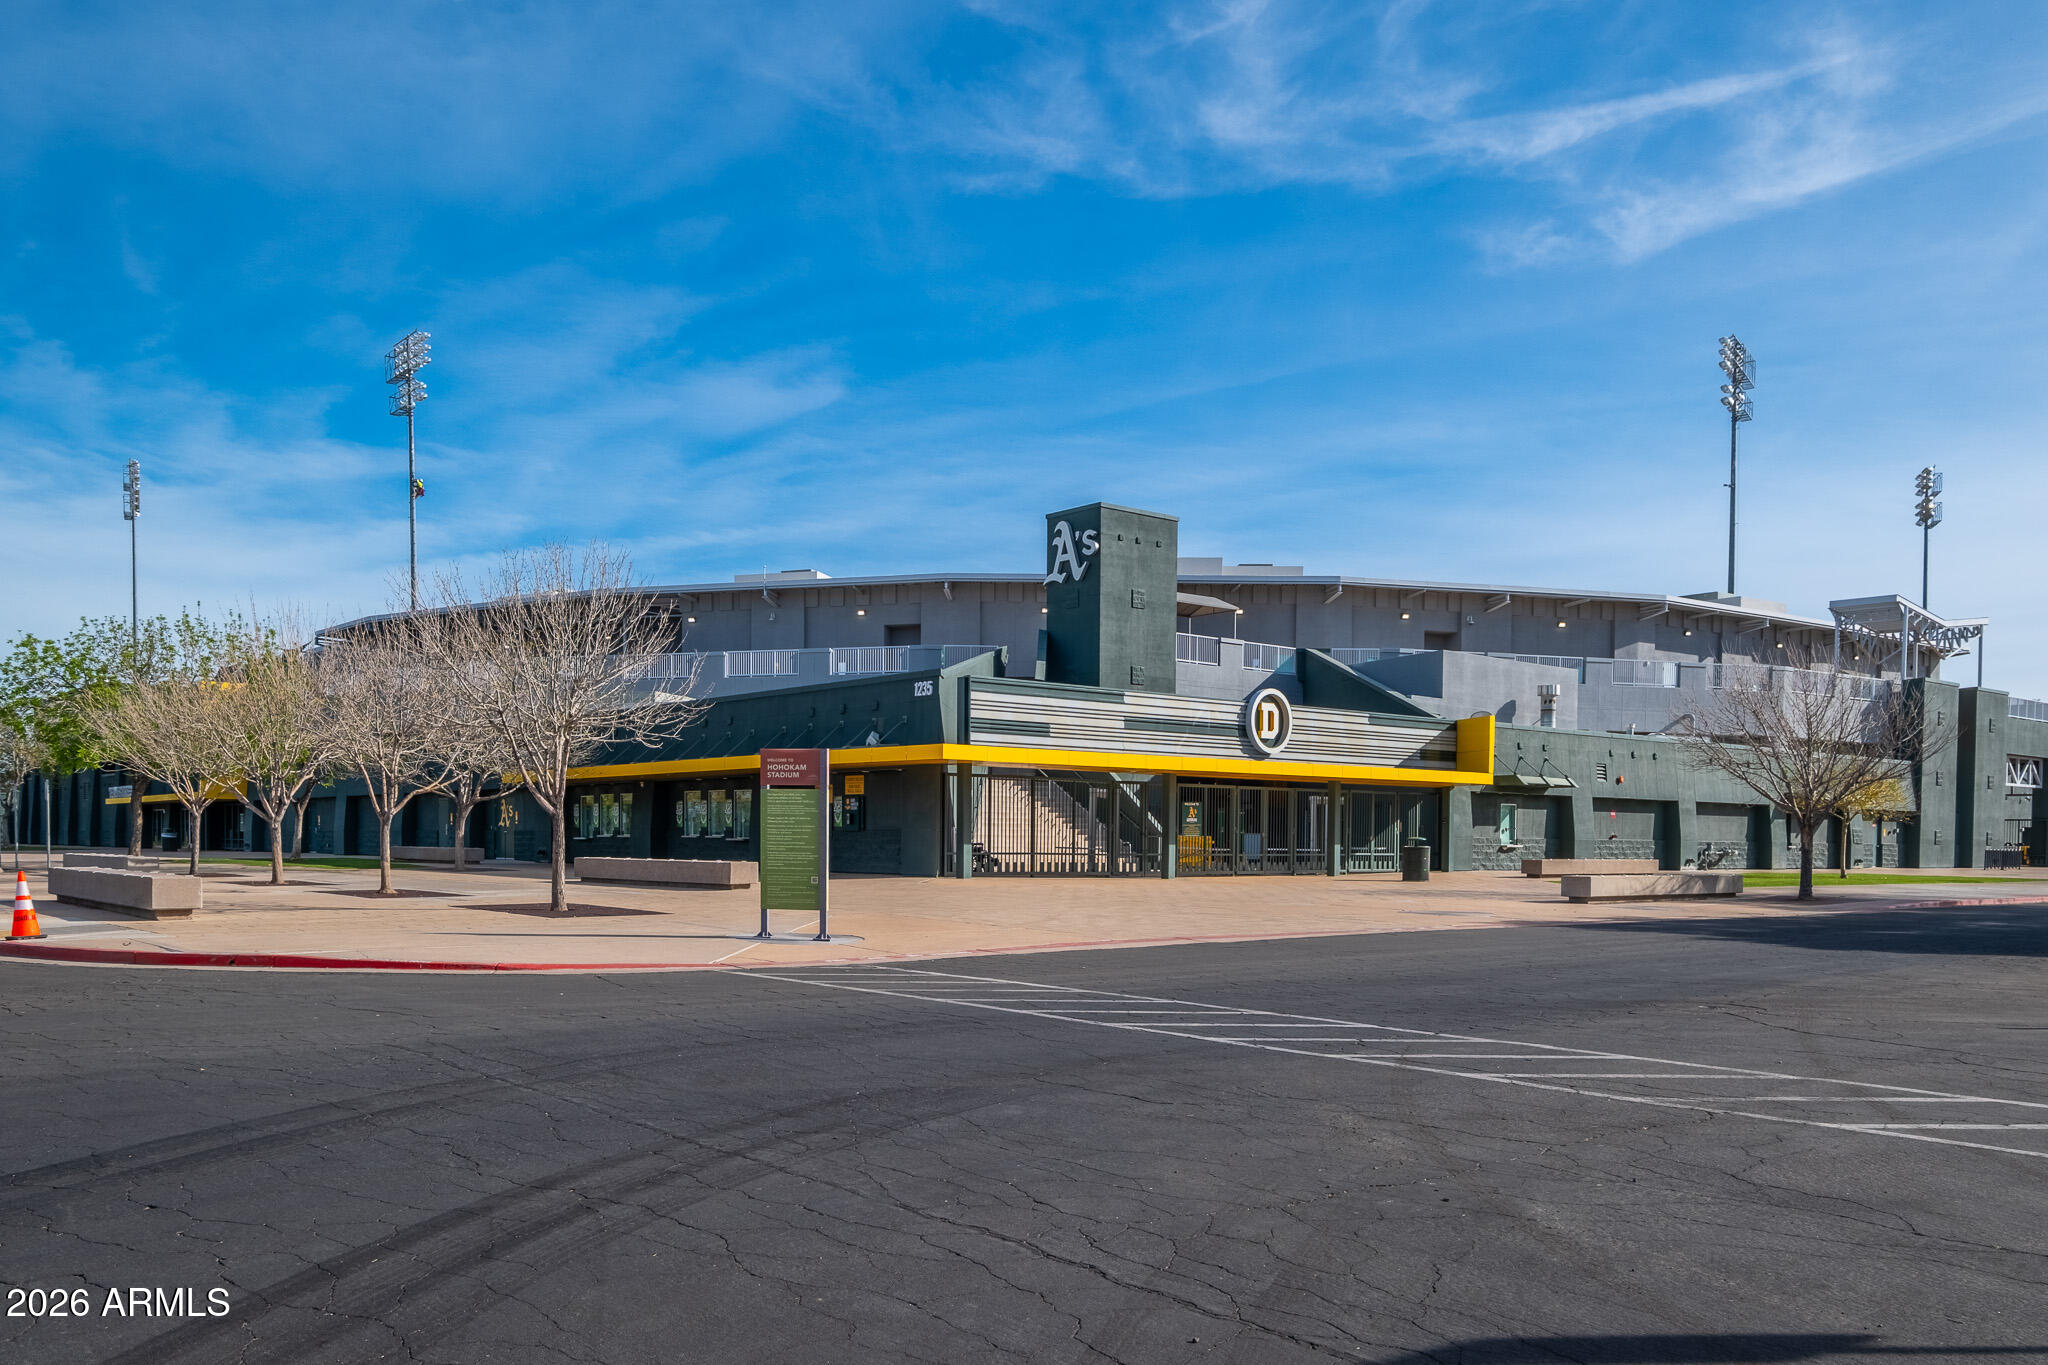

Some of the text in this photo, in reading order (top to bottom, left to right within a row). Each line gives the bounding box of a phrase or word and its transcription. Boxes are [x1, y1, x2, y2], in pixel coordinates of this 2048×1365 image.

[1043, 520, 1100, 586] A's
[914, 680, 934, 697] 1235
[1259, 701, 1280, 739] D
